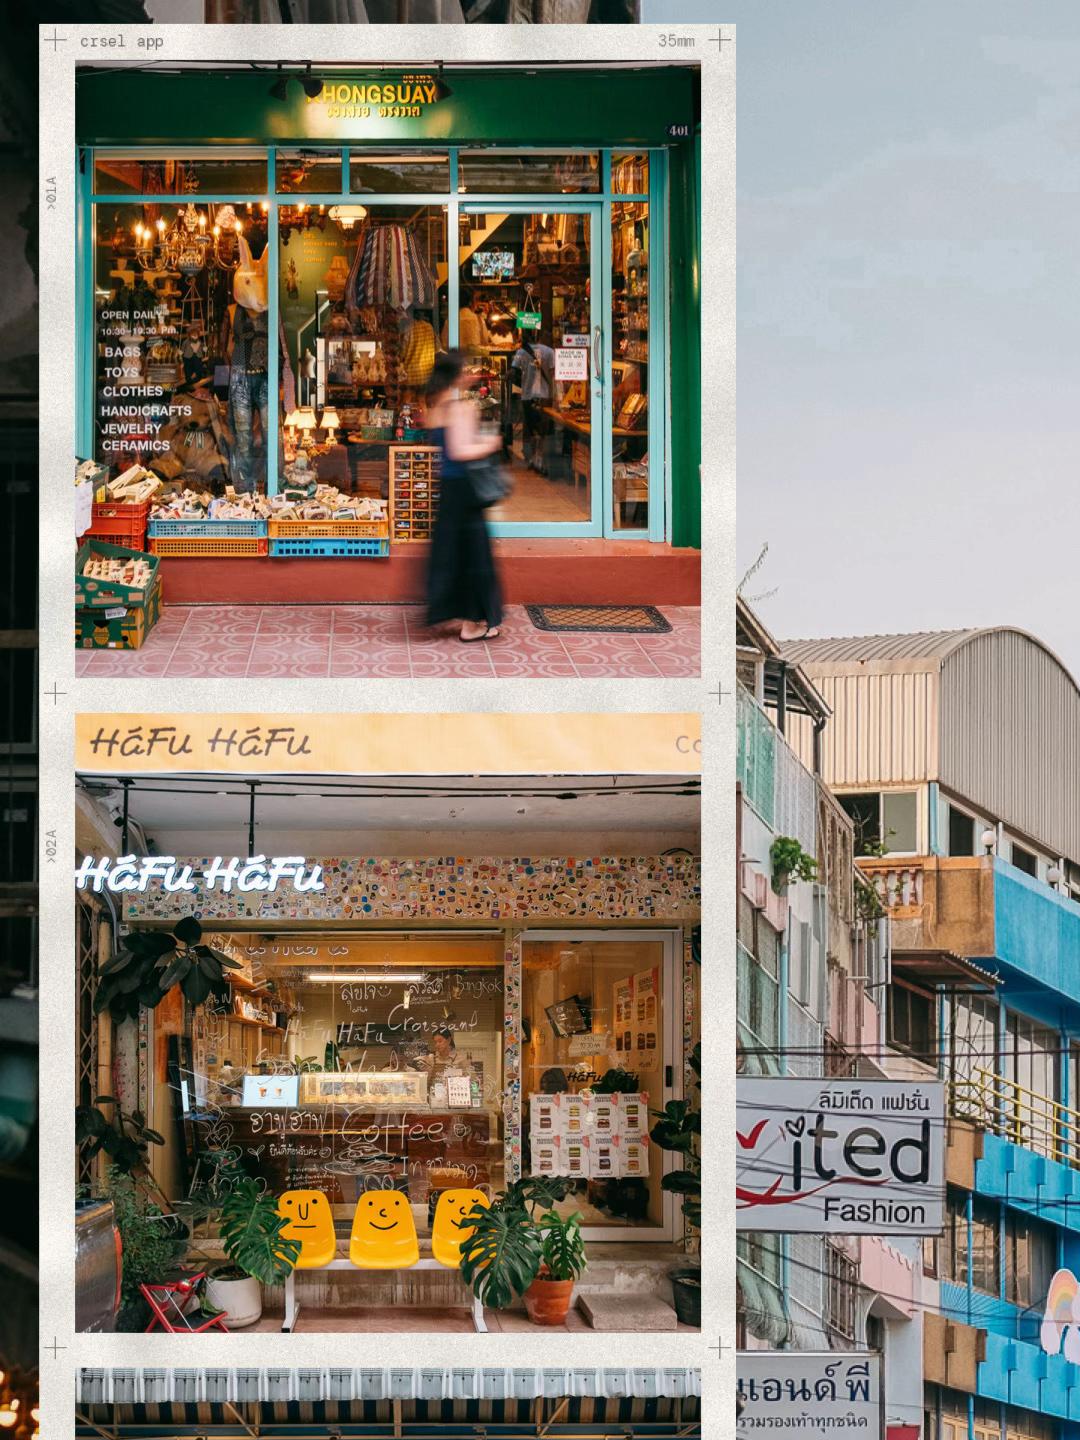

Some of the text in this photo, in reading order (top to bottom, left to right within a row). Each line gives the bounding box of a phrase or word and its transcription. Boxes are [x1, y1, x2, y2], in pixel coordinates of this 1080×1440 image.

[307, 84, 438, 104] HONGSUAY
[101, 310, 163, 320] OPEN DAILY
[104, 346, 141, 358] BAGS
[104, 367, 139, 378] TOYS
[103, 385, 164, 398] CLOTHES
[101, 405, 192, 417] HANDICRAFTS
[101, 423, 162, 435] JEWELRY
[102, 440, 170, 451] CERAMICS
[818, 1088, 930, 1111] ลิมิเต็ด แฟชั่น
[824, 1197, 925, 1224] Fashion
